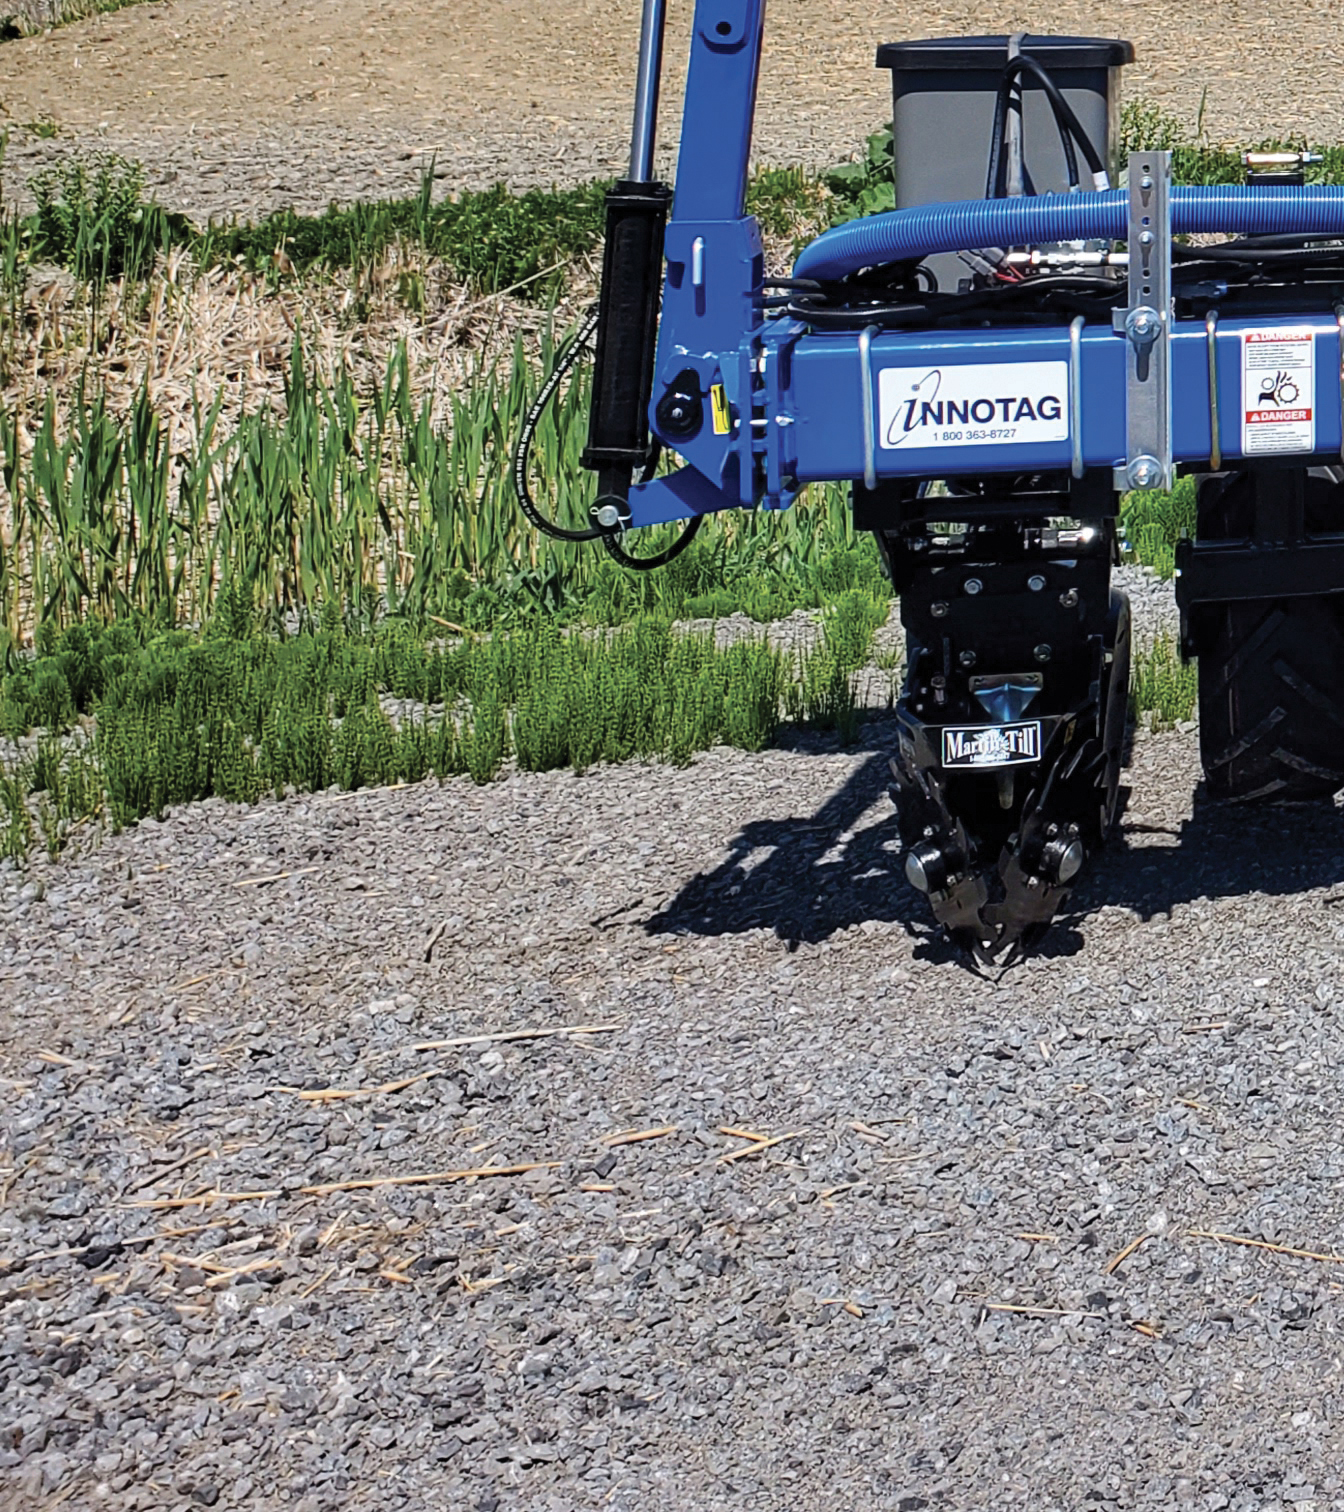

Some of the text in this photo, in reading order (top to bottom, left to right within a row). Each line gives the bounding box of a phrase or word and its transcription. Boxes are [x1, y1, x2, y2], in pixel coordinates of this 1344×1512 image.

[1260, 410, 1307, 422] DANGER
[933, 428, 1017, 441] 1 800 363-8727
